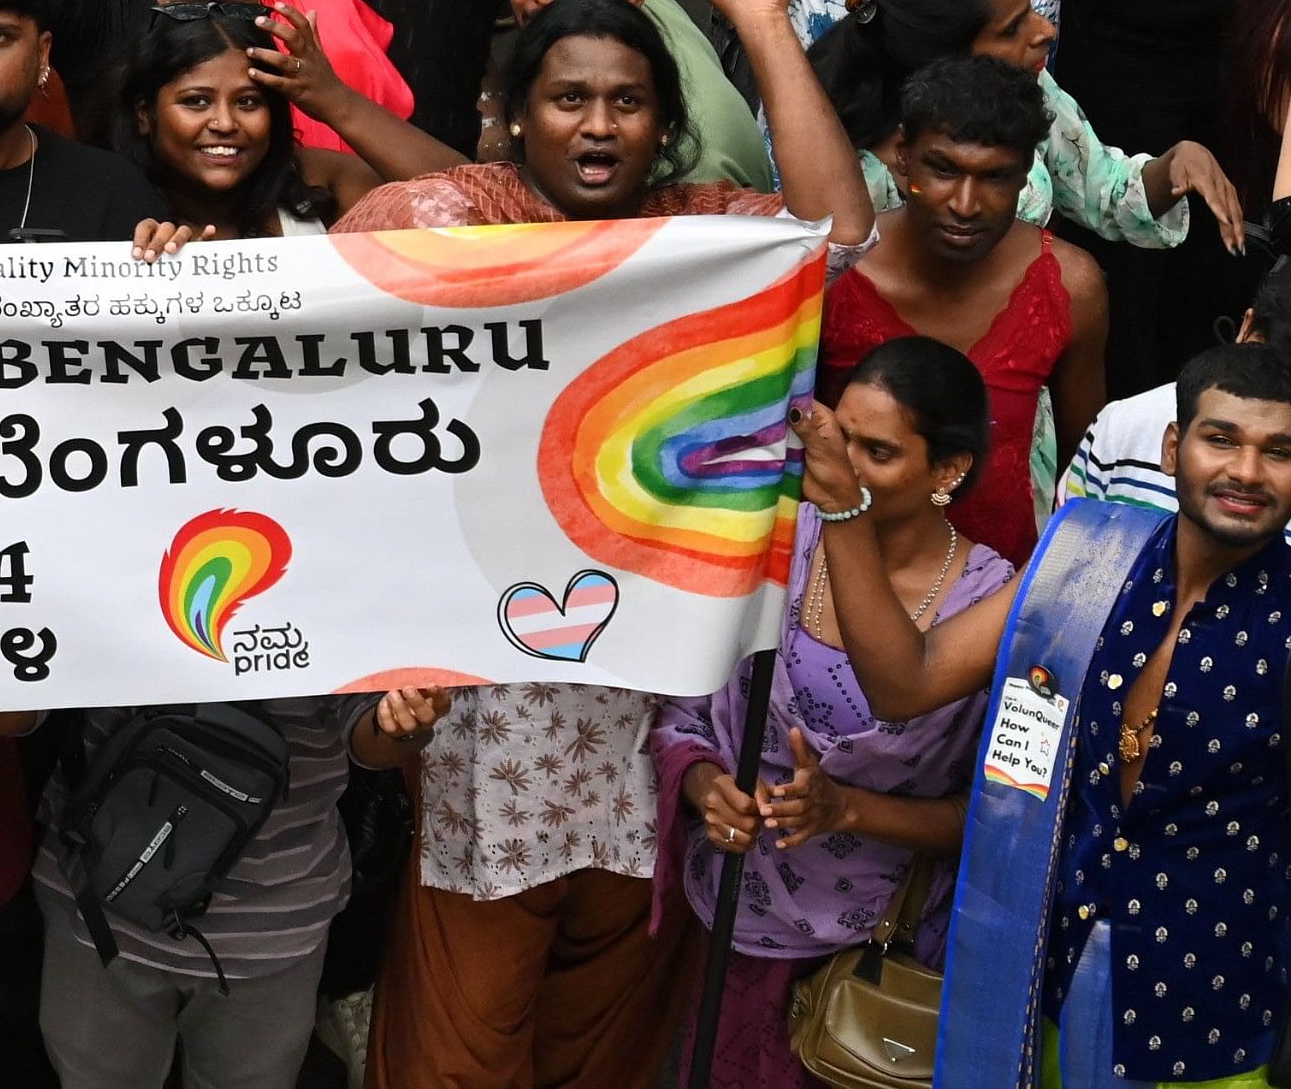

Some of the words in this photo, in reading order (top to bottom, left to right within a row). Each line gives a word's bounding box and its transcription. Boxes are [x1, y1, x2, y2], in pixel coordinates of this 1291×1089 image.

[63, 255, 183, 281] Minority
[192, 252, 279, 280] Rights
[109, 290, 204, 324] ಹಕ್ಕುಗಳ
[234, 649, 310, 676] pride
[1000, 717, 1030, 734] How
[1004, 701, 1061, 731] VolunQueer
[997, 734, 1021, 749] Can
[1024, 740, 1030, 751] I
[992, 749, 1021, 767] Help
[1024, 757, 1048, 778] You?
